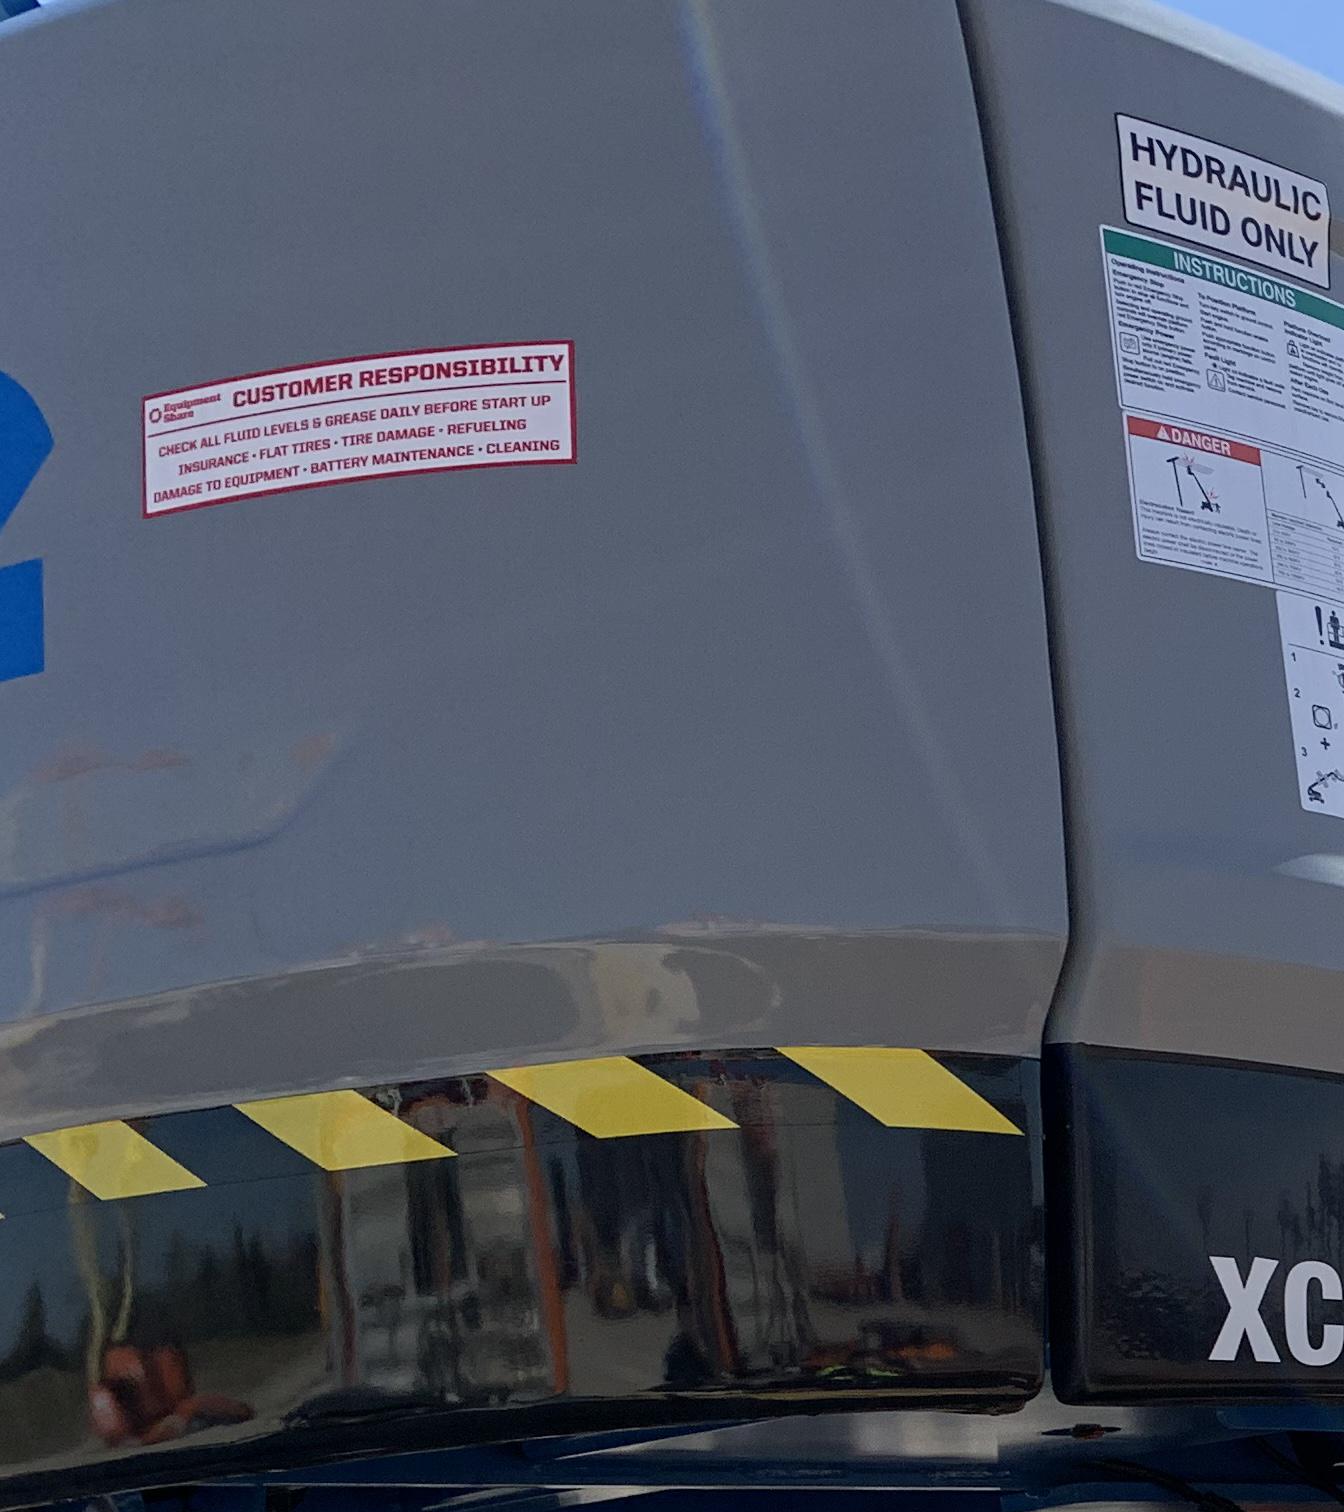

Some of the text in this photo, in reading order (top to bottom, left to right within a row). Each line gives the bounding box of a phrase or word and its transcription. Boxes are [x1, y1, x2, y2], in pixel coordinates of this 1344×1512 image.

[1130, 132, 1322, 222] HYDRAULIC
[1135, 180, 1319, 268] FLUID ONLY
[1173, 251, 1297, 308] INSTRUCTIONS
[164, 393, 221, 412] Equipment
[233, 354, 564, 407] CUSTOMER RESPONSIBILITY
[159, 395, 551, 457] CHECK ALL FLUID LEVELS & GREASE DAILY BEFORE START UP
[164, 411, 194, 423] Share
[1171, 427, 1232, 456] DANGER
[153, 439, 560, 503] DAMAGE TO EQUIPMENT BATTERY MAINTENANCE CLEANING
[179, 418, 527, 476] INSURANCE FLAT TIRES TIRE DAMAGE REFUELING
[1293, 687, 1300, 698] 2
[1301, 747, 1308, 757] 3
[1209, 1255, 1344, 1367] XC
